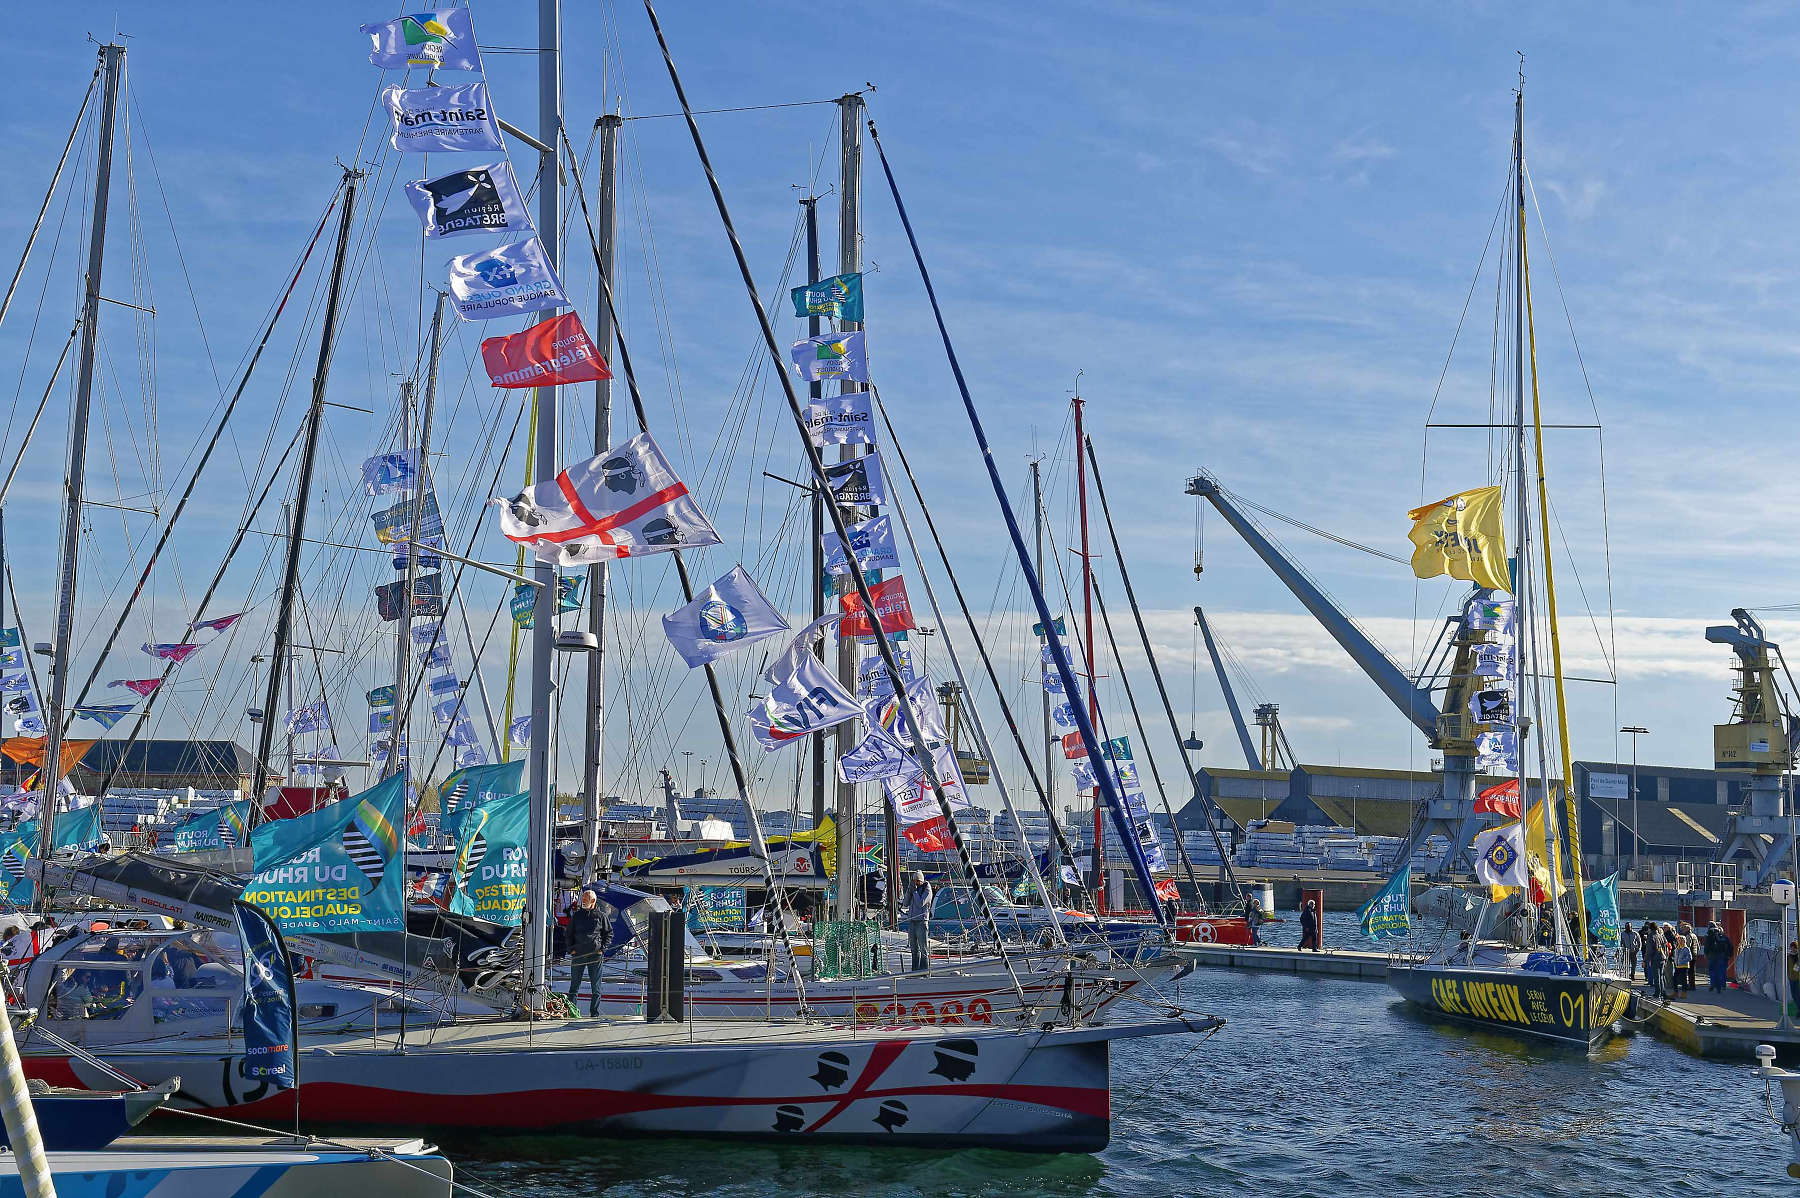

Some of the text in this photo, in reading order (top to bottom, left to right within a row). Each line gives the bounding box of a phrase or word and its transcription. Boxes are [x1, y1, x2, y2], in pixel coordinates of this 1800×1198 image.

[481, 865, 508, 881] DU
[1783, 889, 1789, 900] F
[1198, 922, 1212, 943] 8
[1526, 988, 1546, 1001] SERVI
[1463, 980, 1531, 1026] JOYEUX
[1531, 1001, 1548, 1012] AVEC
[1559, 991, 1584, 1031] 01
